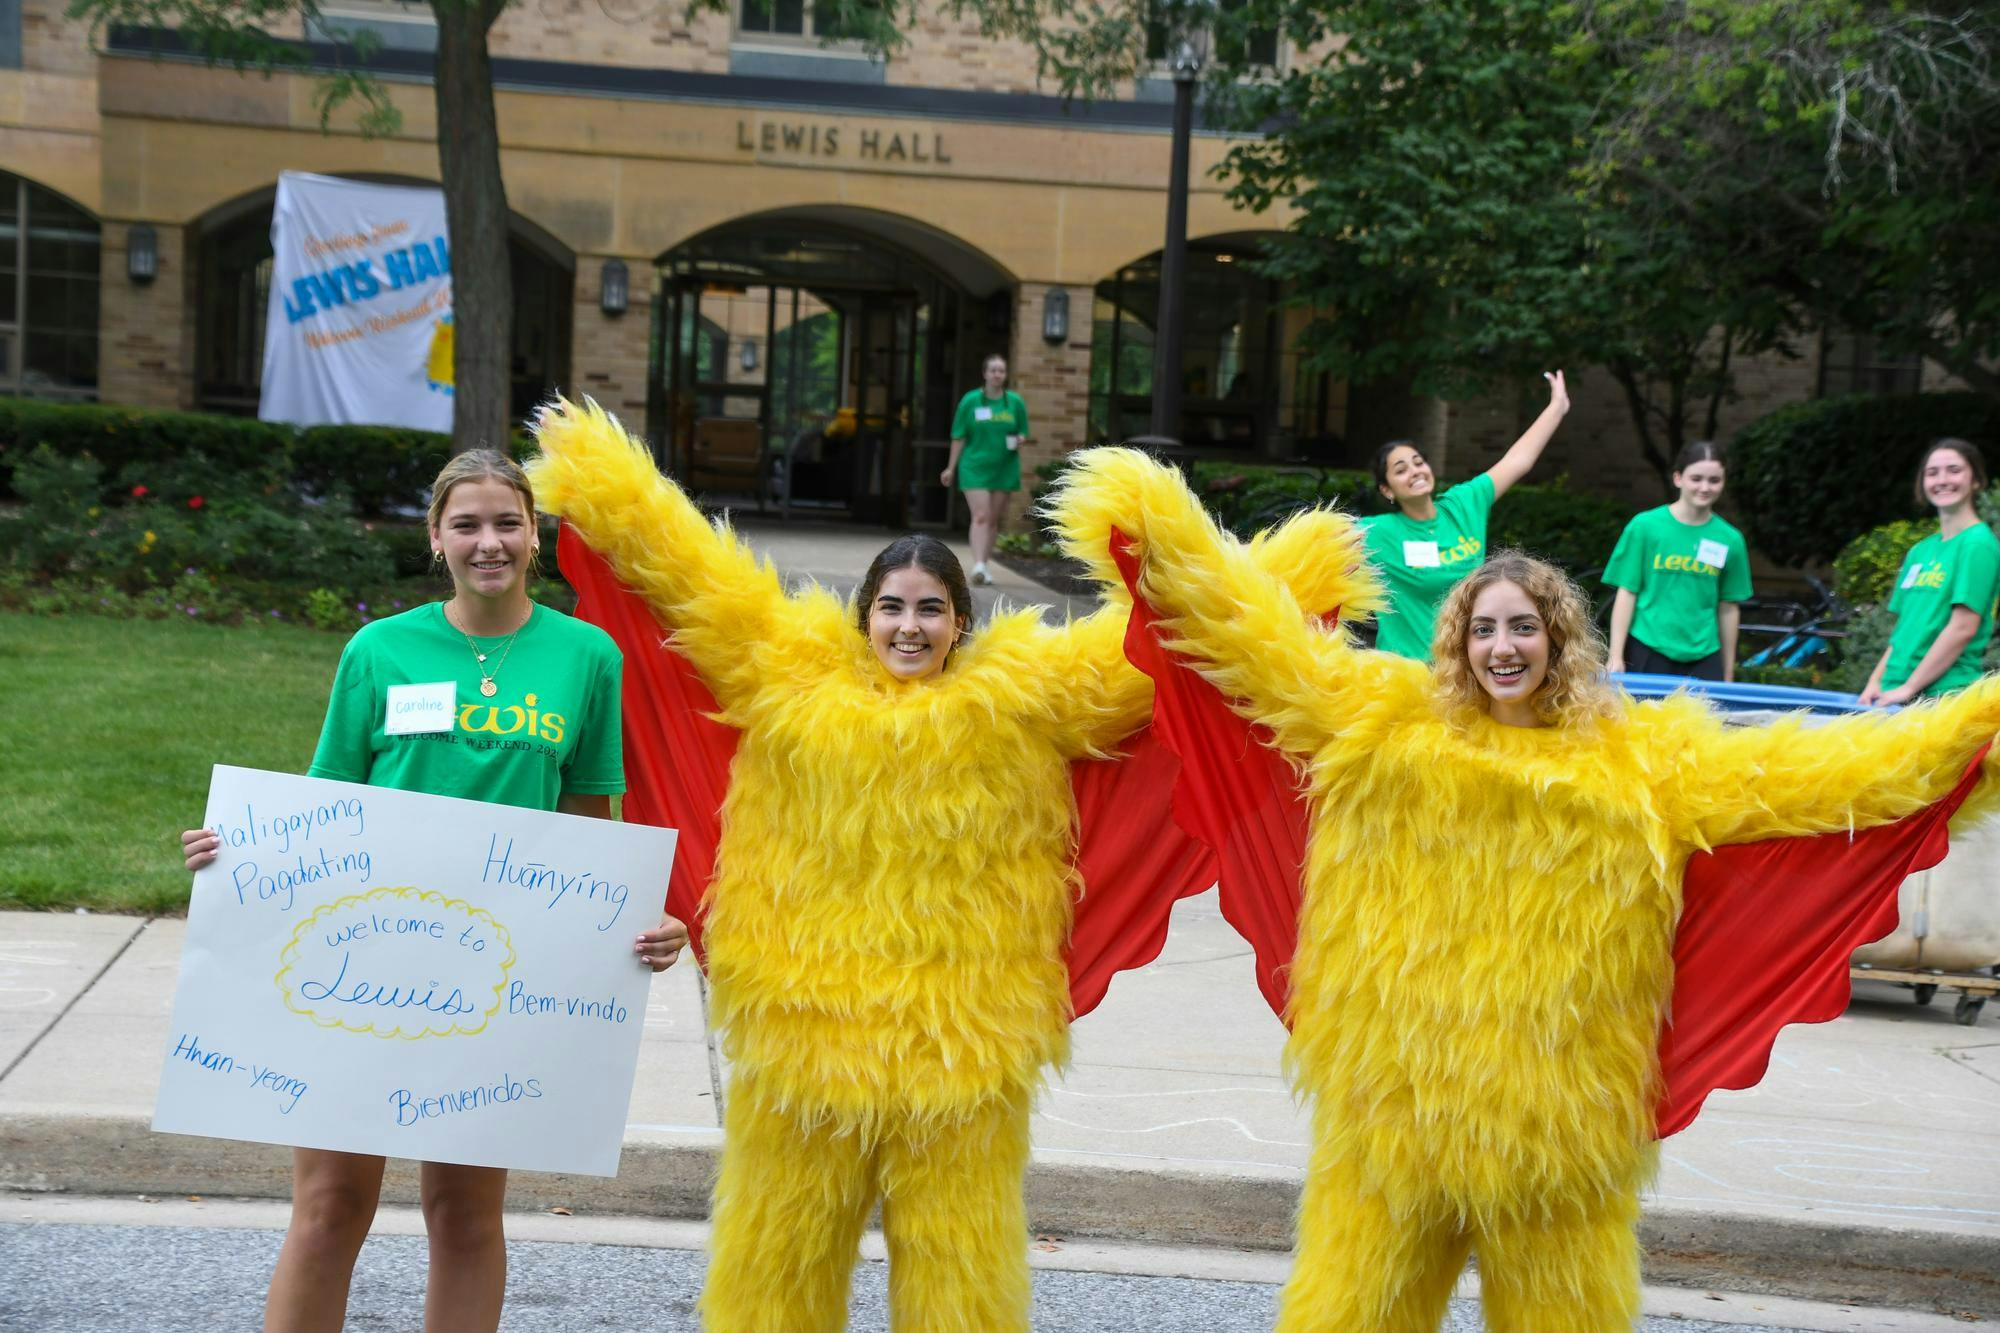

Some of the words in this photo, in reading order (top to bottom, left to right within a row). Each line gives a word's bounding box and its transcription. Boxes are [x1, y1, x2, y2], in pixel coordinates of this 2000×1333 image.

[736, 119, 840, 157] LEWIS
[859, 129, 953, 164] HALL
[284, 260, 379, 323] LEWIS
[383, 236, 450, 289] HAL
[1439, 535, 1481, 564] wis
[1653, 554, 1720, 576] Lew
[456, 693, 566, 743] wis
[397, 732, 459, 745] WELCOME
[465, 736, 532, 751] WEEKEND
[536, 744, 560, 759] 202
[232, 847, 372, 911] Pagdating
[458, 925, 486, 952] to
[300, 951, 475, 1016] Lewis
[508, 979, 628, 1024] Bem-vindo
[172, 1033, 308, 1115] Hwan-yeong
[388, 1072, 543, 1127] Bienvenidos
